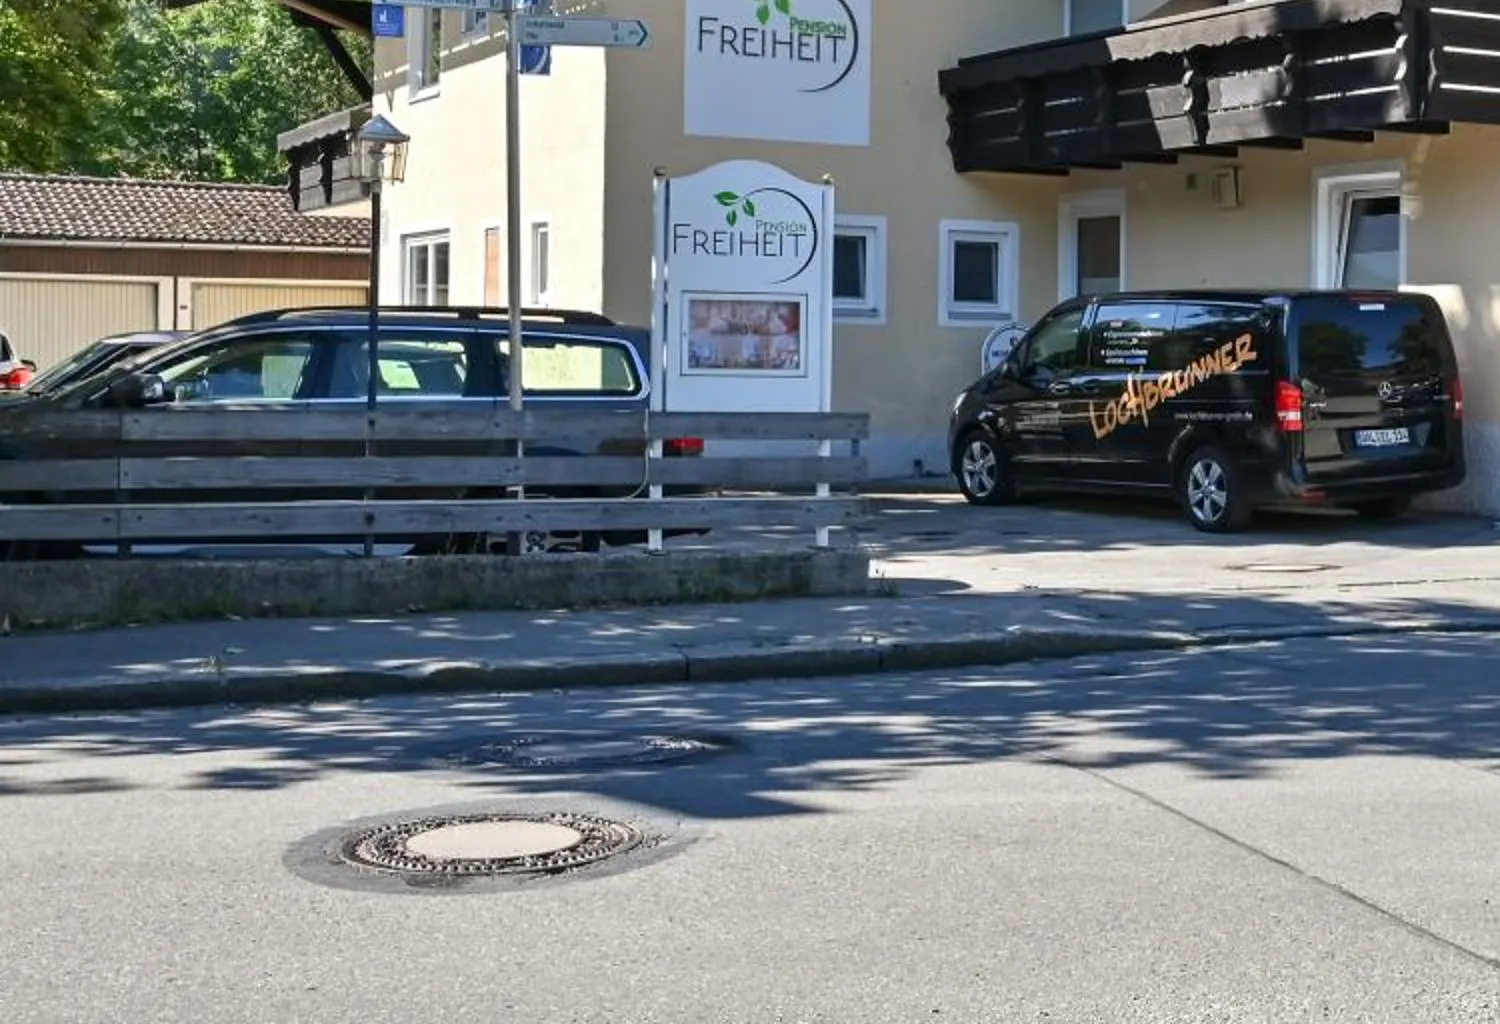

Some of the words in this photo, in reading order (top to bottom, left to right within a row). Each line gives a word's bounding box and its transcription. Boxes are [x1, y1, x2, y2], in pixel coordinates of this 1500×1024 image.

[789, 16, 846, 35] PENSION
[698, 16, 846, 63] FREIHEIT
[756, 219, 807, 233] PENSION
[673, 223, 807, 257] FREIHEIT
